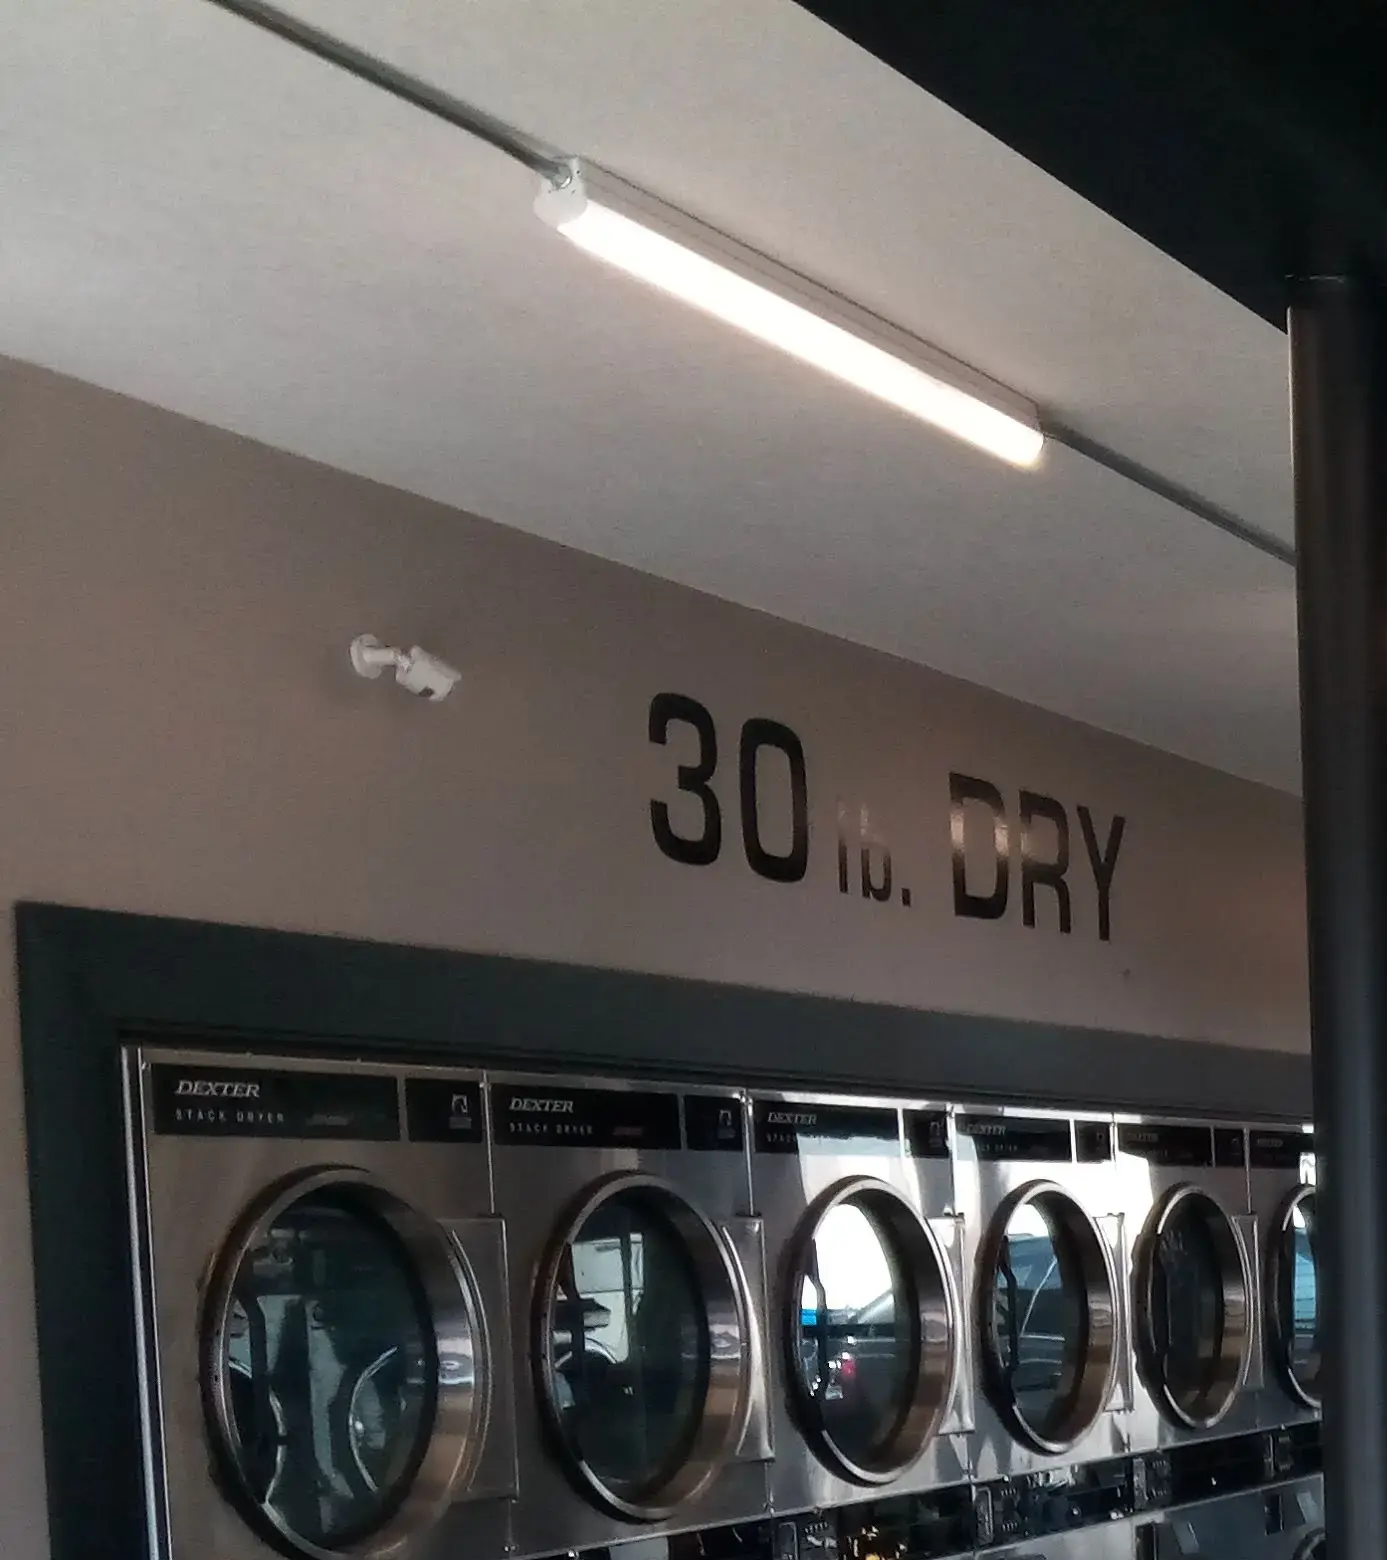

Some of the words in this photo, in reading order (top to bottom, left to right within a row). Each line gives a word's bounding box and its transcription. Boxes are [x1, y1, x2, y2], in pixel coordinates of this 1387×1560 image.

[649, 692, 809, 883] 30
[836, 798, 911, 908] lb.
[949, 770, 1126, 942] DRY
[175, 1079, 261, 1098] DEXTER
[508, 1097, 575, 1113] DEXTER
[766, 1111, 818, 1126] DEXTER
